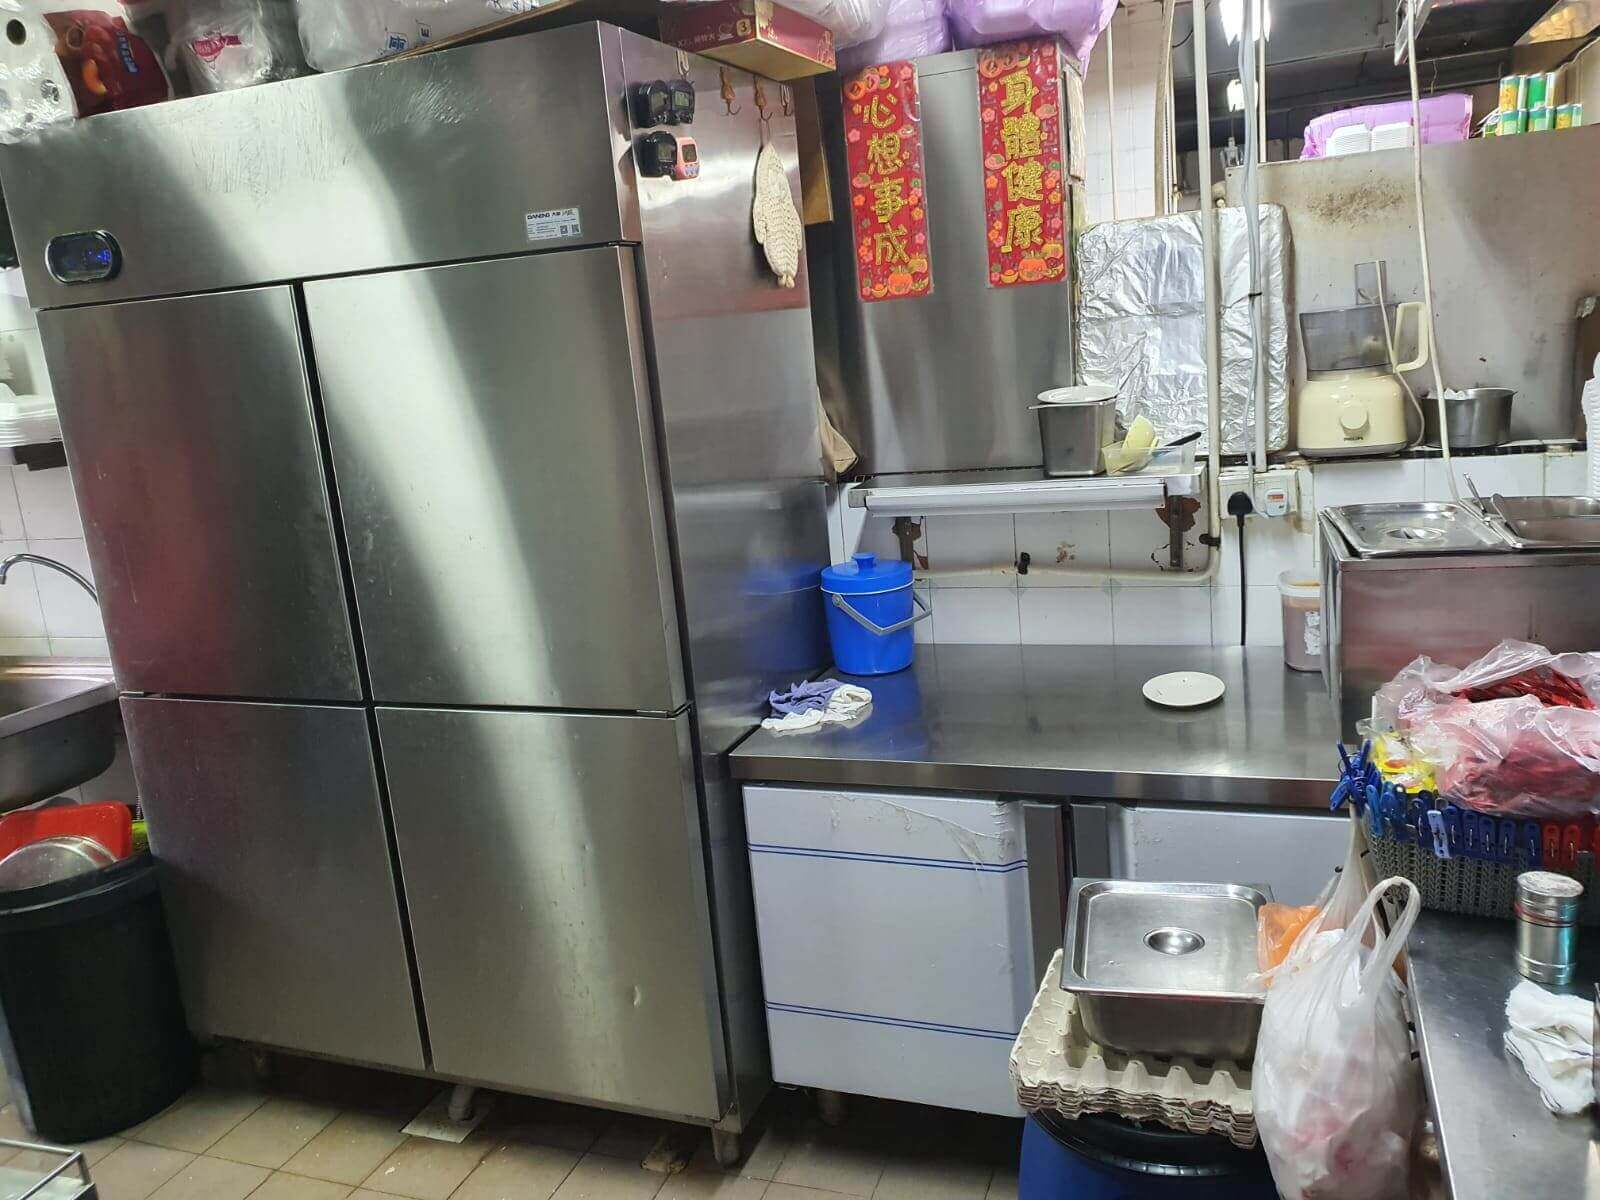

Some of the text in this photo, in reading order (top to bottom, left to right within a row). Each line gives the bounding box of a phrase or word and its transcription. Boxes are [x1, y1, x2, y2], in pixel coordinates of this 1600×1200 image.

[862, 92, 911, 266] 心想事成
[999, 68, 1044, 254] 身體健康
